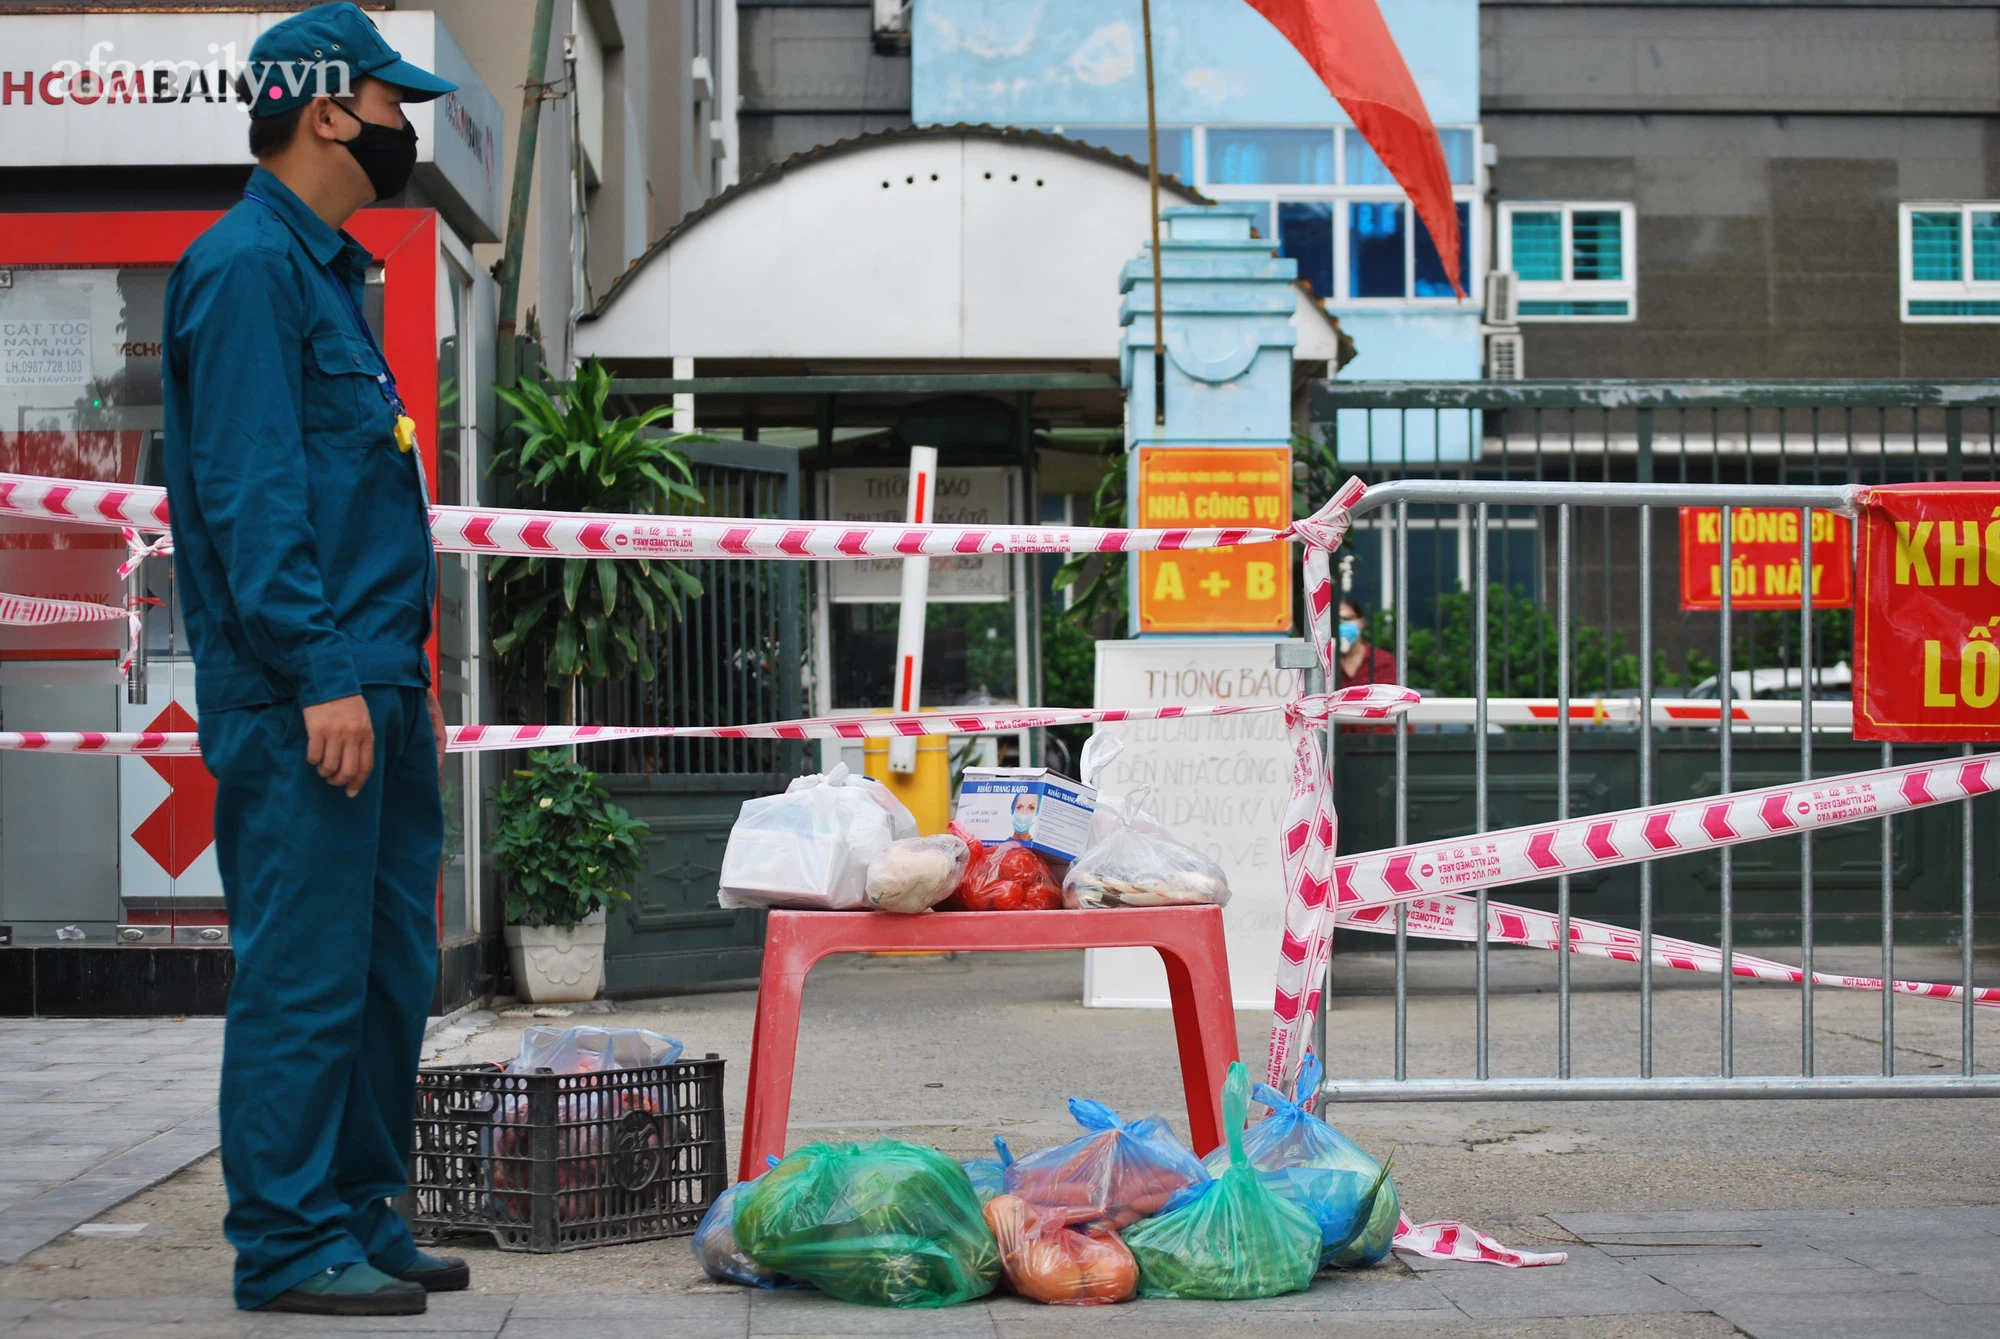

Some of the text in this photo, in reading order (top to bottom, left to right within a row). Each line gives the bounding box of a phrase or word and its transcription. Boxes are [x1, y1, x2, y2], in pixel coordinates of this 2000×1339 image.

[4, 338, 48, 346] NAM
[5, 361, 82, 374] LH:0987.728.103
[1148, 491, 1280, 524] NHÀ CÔNG VỤ
[1152, 561, 1186, 601] A
[1246, 561, 1277, 600] B
[1144, 660, 1234, 699] THÔNG
[1215, 750, 1277, 785] CÔNG
[1814, 794, 1876, 810] NOT ALLOWED AREA
[1438, 856, 1500, 873] NOT ALLOWED AREA
[1488, 866, 1502, 876] KHU
[1412, 899, 1456, 915] 禁區勿
[1440, 917, 1454, 927] NOT
